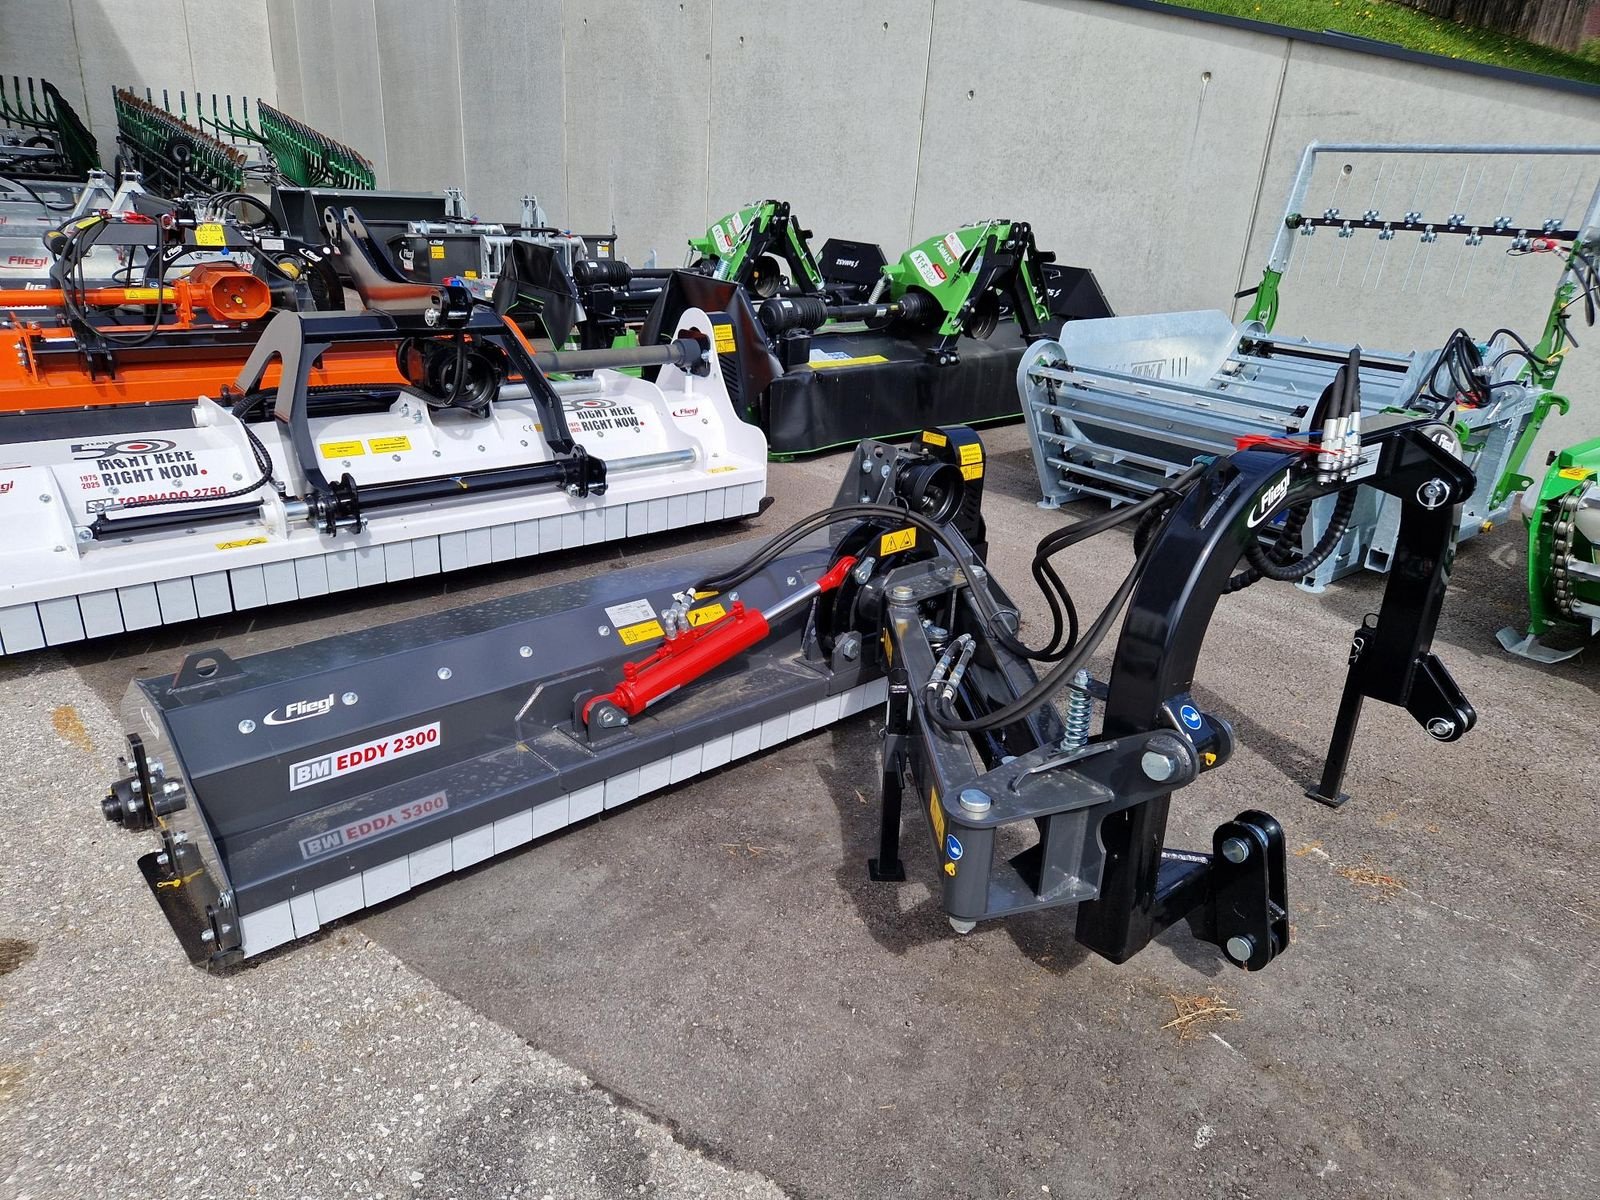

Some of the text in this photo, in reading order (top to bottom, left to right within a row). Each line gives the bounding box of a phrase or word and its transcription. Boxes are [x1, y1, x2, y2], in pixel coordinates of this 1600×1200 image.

[8, 256, 48, 267] Fliegl
[609, 406, 635, 417] HERE
[581, 419, 613, 432] RIGHT
[154, 450, 195, 465] HERE
[79, 474, 98, 483] 1975
[101, 468, 153, 487] RIGHT
[82, 481, 101, 490] 2025
[193, 486, 227, 497] 2750
[1260, 468, 1291, 513] Fliegl
[286, 693, 335, 718] Fliegl
[296, 728, 438, 784] BM EDDY 2300
